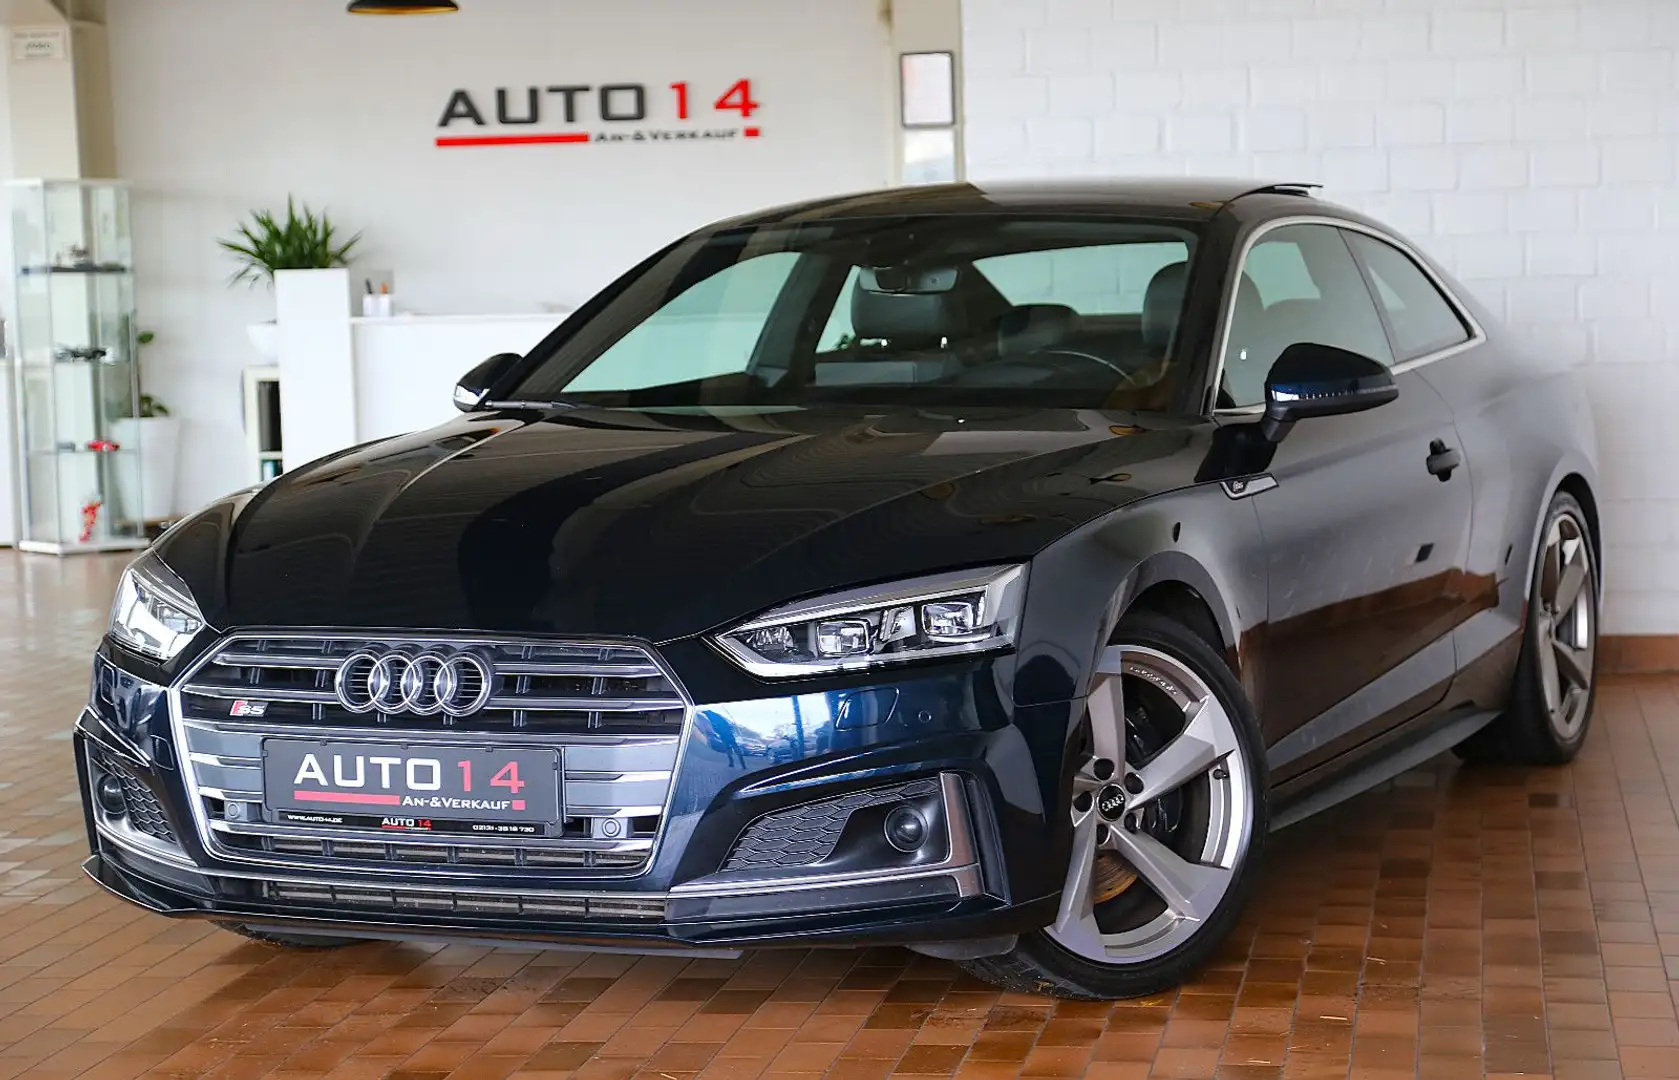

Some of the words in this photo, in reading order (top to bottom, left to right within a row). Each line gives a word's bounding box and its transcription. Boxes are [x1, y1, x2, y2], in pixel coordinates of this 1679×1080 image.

[437, 83, 647, 128] AUTO
[669, 78, 760, 120] 14
[293, 753, 441, 791] AUTO
[457, 759, 525, 794] 14
[381, 817, 415, 827] AUTO
[418, 819, 432, 827] 14
